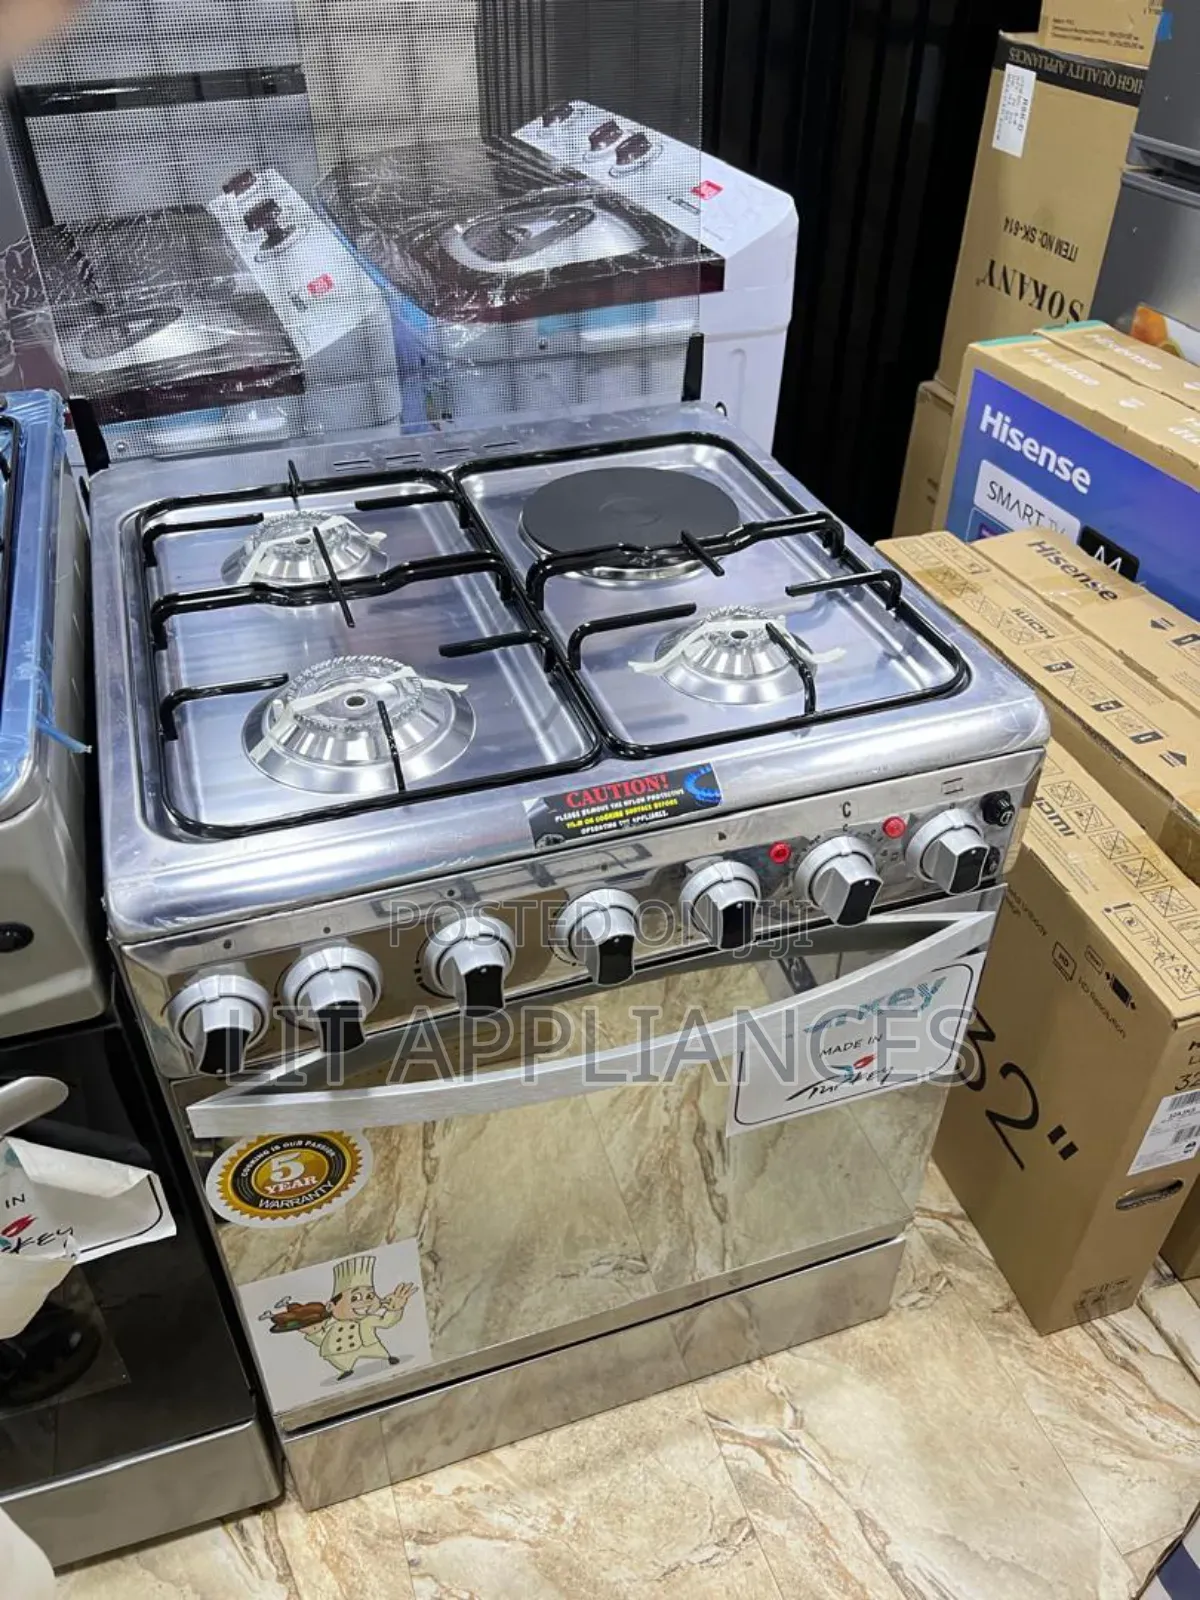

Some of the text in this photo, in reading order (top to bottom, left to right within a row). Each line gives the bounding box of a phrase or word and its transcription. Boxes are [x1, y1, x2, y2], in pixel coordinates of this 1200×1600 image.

[1008, 46, 1066, 76] APPLIANCES
[1066, 59, 1117, 88] QUALITY
[1055, 242, 1079, 262] ITEM
[978, 403, 1092, 495] Hisense
[986, 480, 1045, 528] SMART
[1027, 539, 1118, 602] Hisense
[565, 773, 670, 808] CAUTION!
[818, 1033, 883, 1058] MADE IN
[270, 1144, 281, 1152] IS
[269, 1151, 305, 1183] 5
[258, 1180, 334, 1209] WARRANTY
[263, 1175, 318, 1195] YEAR
